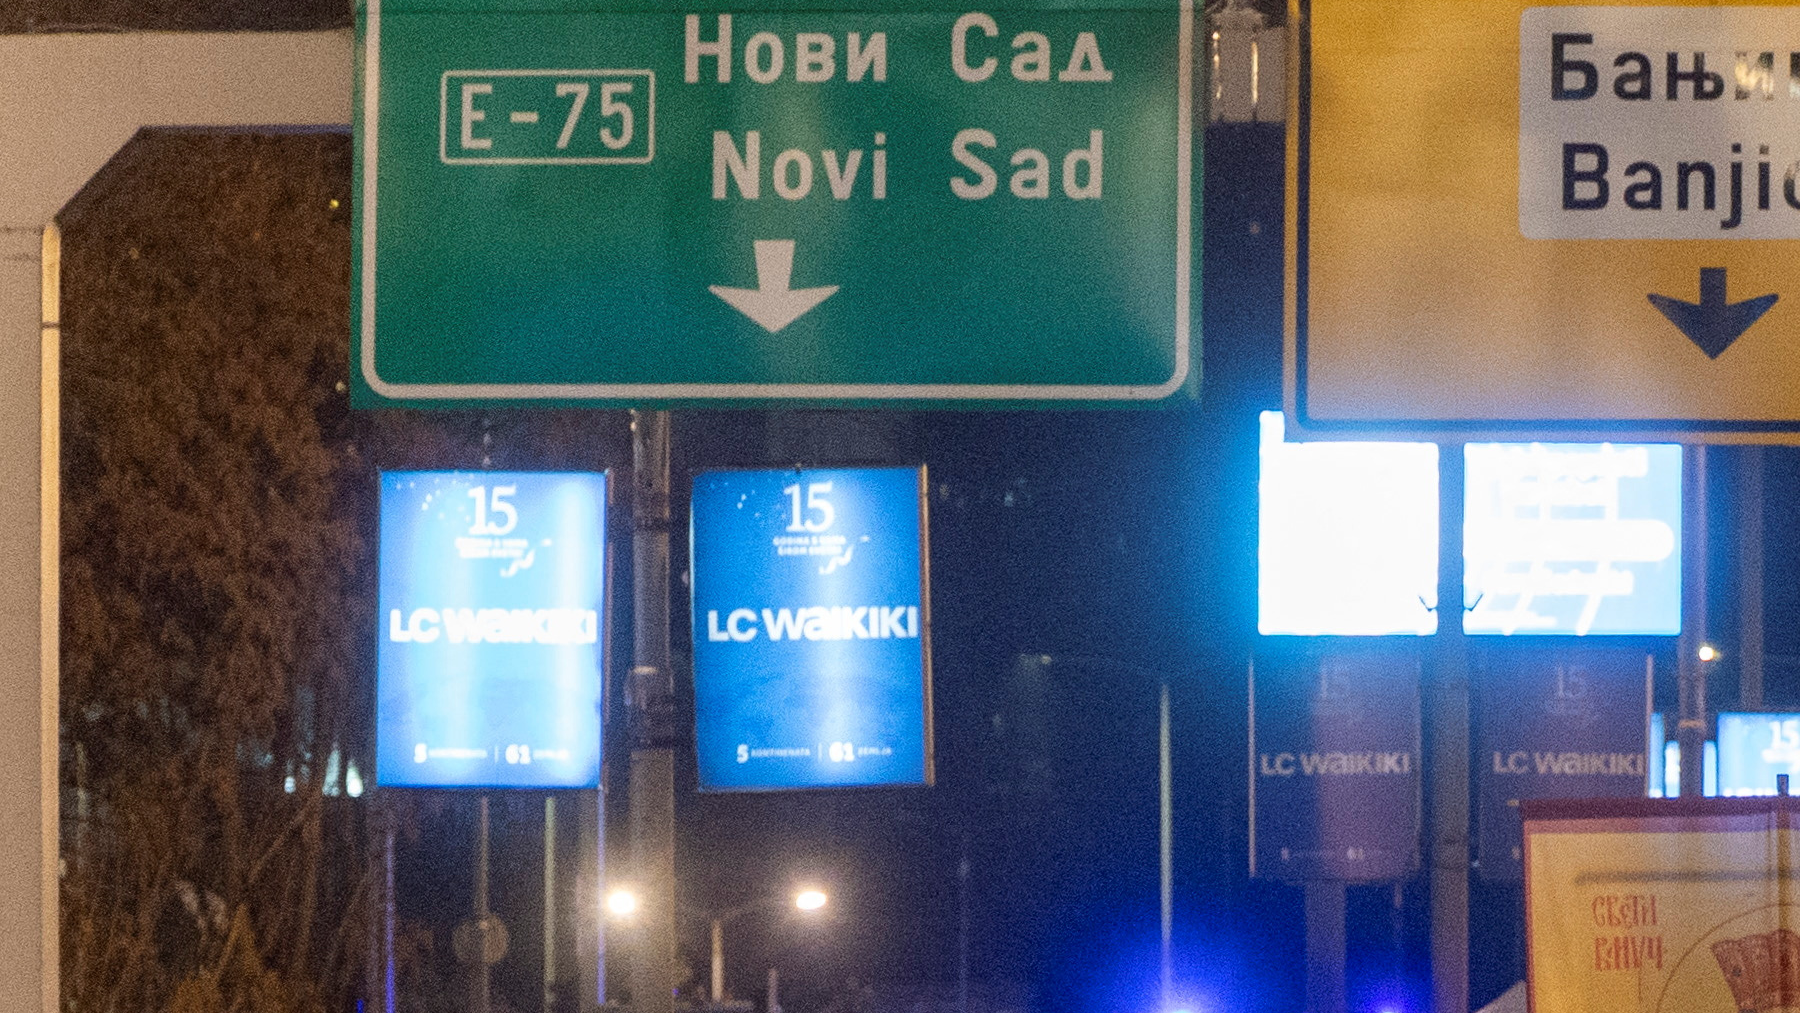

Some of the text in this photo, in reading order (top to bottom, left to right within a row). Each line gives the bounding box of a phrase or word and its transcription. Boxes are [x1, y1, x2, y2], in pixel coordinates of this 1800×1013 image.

[684, 12, 1114, 83] Нови Сад
[461, 82, 636, 150] E-75
[712, 128, 1105, 201] Novi Sad
[467, 484, 518, 535] 15
[783, 481, 835, 533] 15
[390, 608, 440, 643] LC
[707, 608, 757, 642] LC
[1769, 720, 1800, 749] 15
[1261, 754, 1295, 776] LC
[1493, 751, 1529, 773] LC
